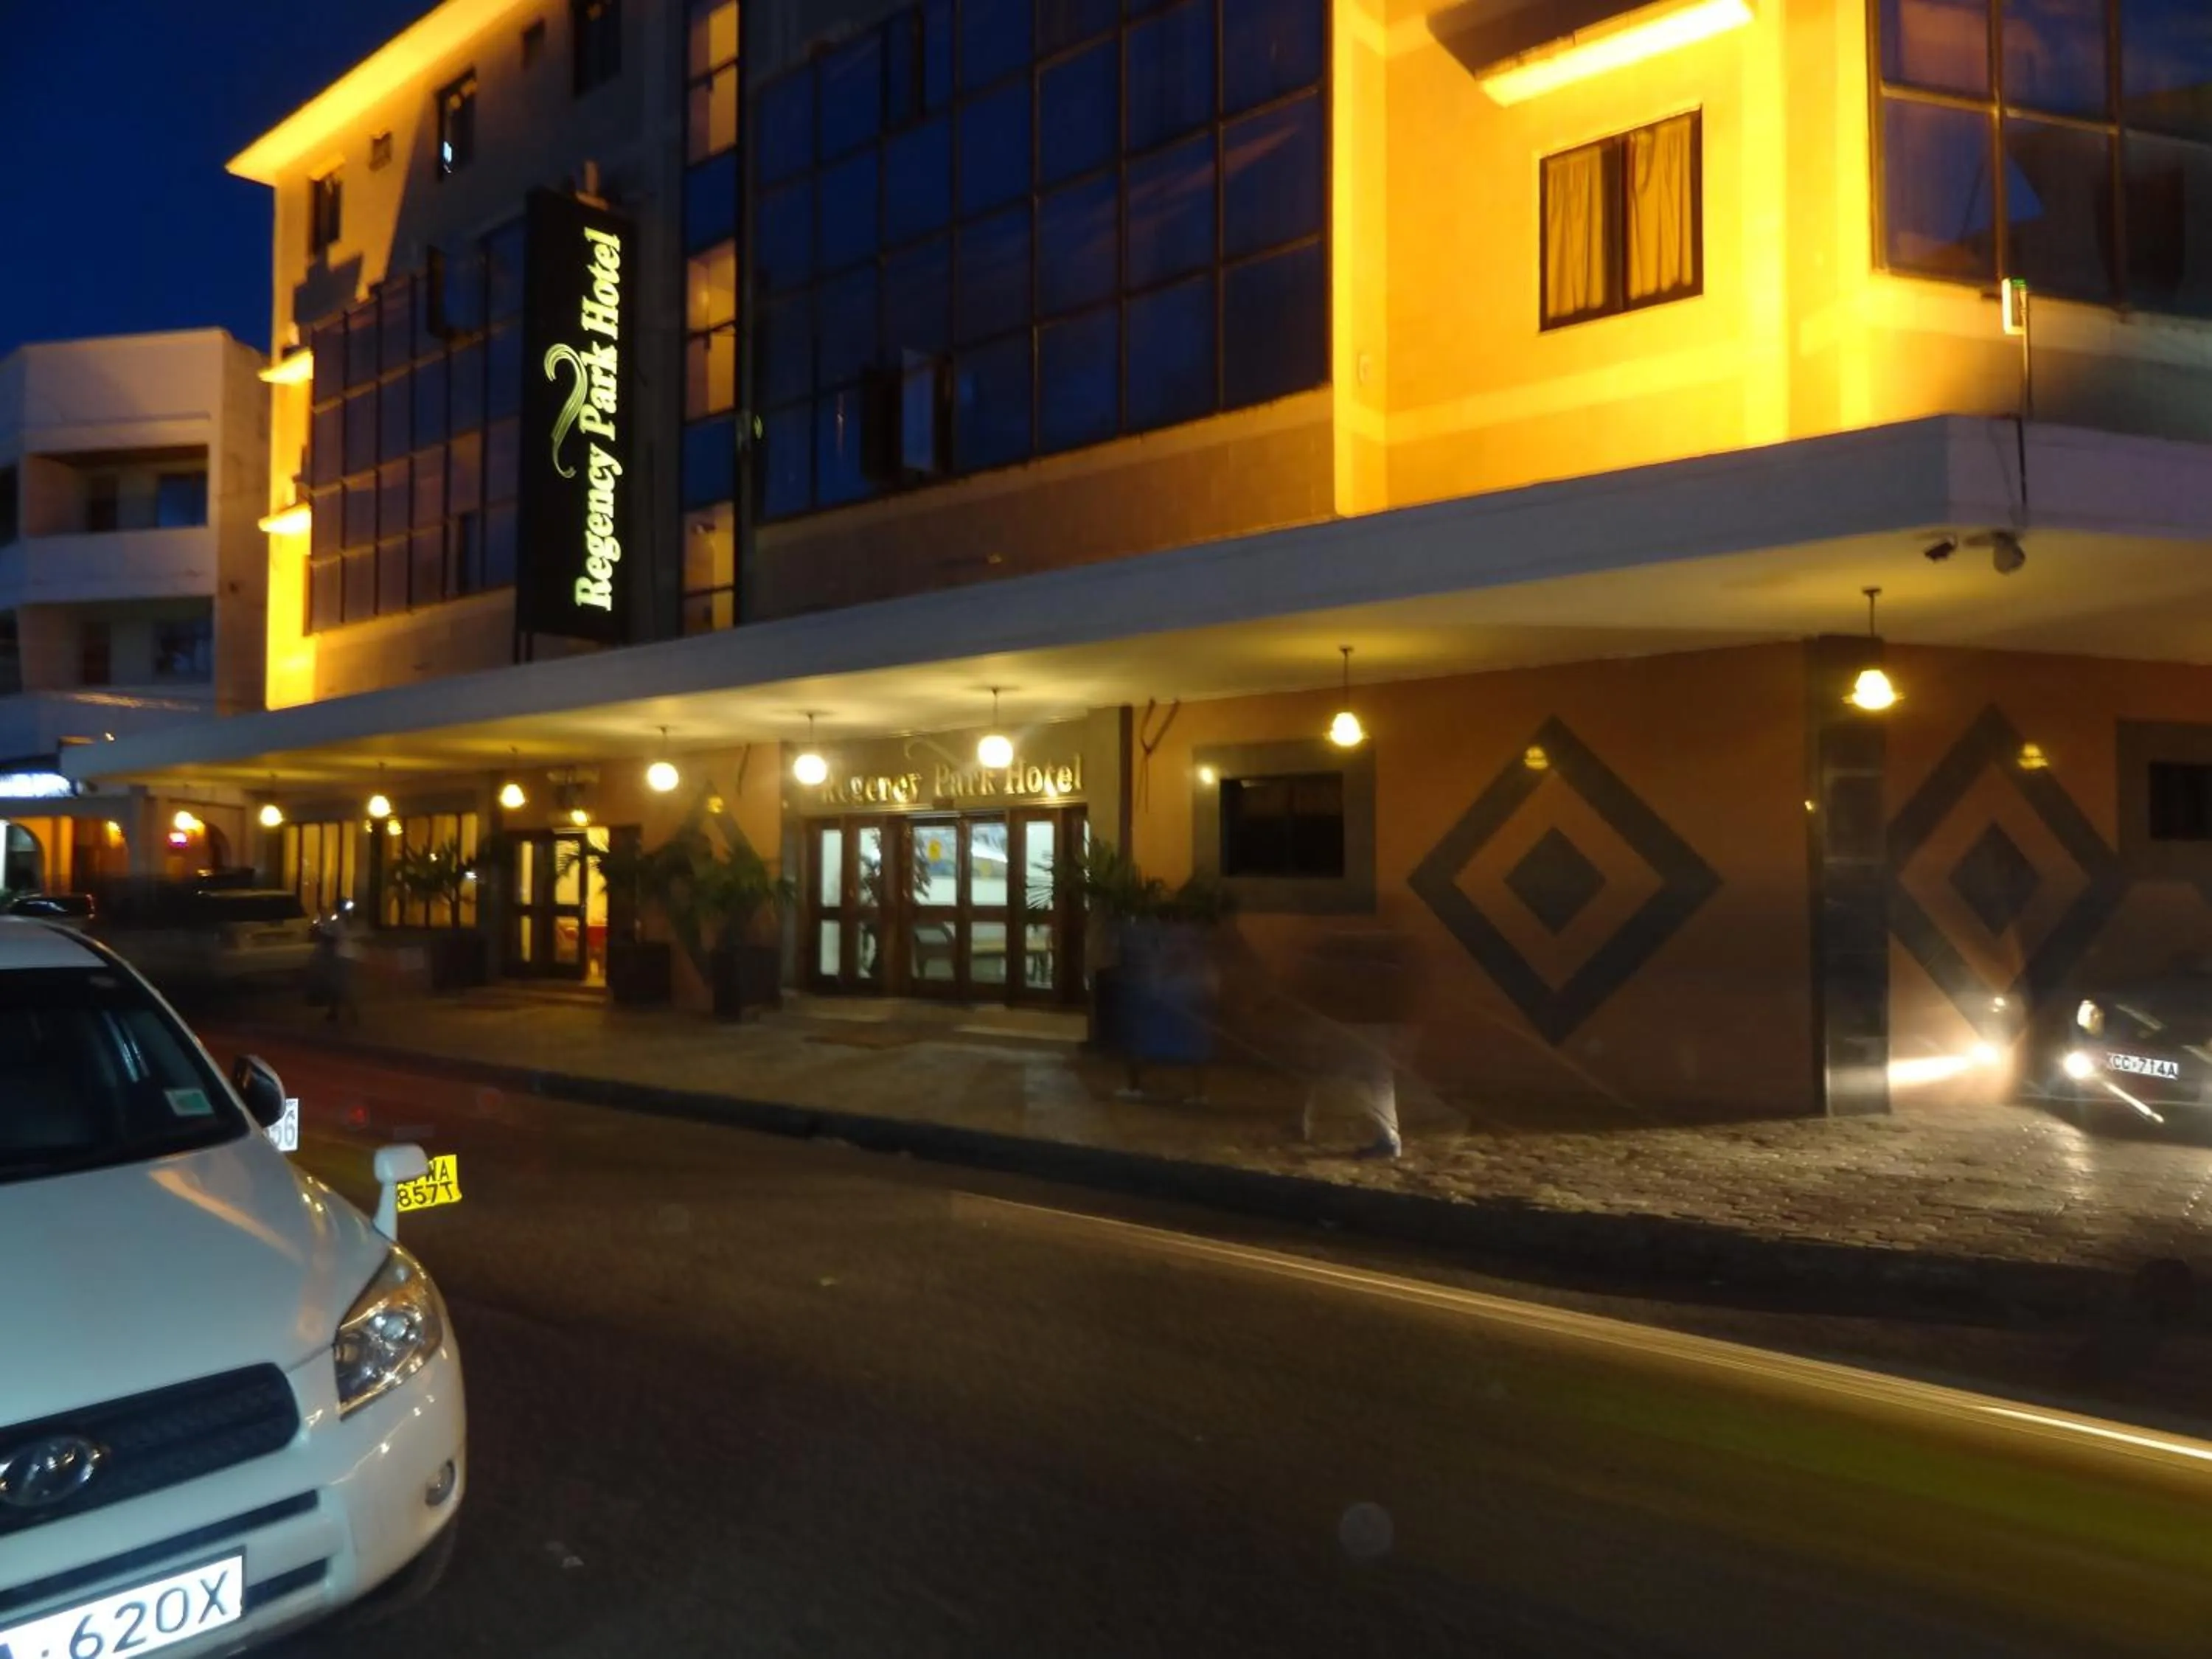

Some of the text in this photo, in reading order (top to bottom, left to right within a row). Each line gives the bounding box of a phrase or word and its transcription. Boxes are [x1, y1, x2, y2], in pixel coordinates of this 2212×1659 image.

[575, 227, 622, 611] Regency Park Hotel
[934, 761, 995, 797] Park
[1004, 753, 1082, 798] Hotel
[398, 1181, 453, 1207] 857T
